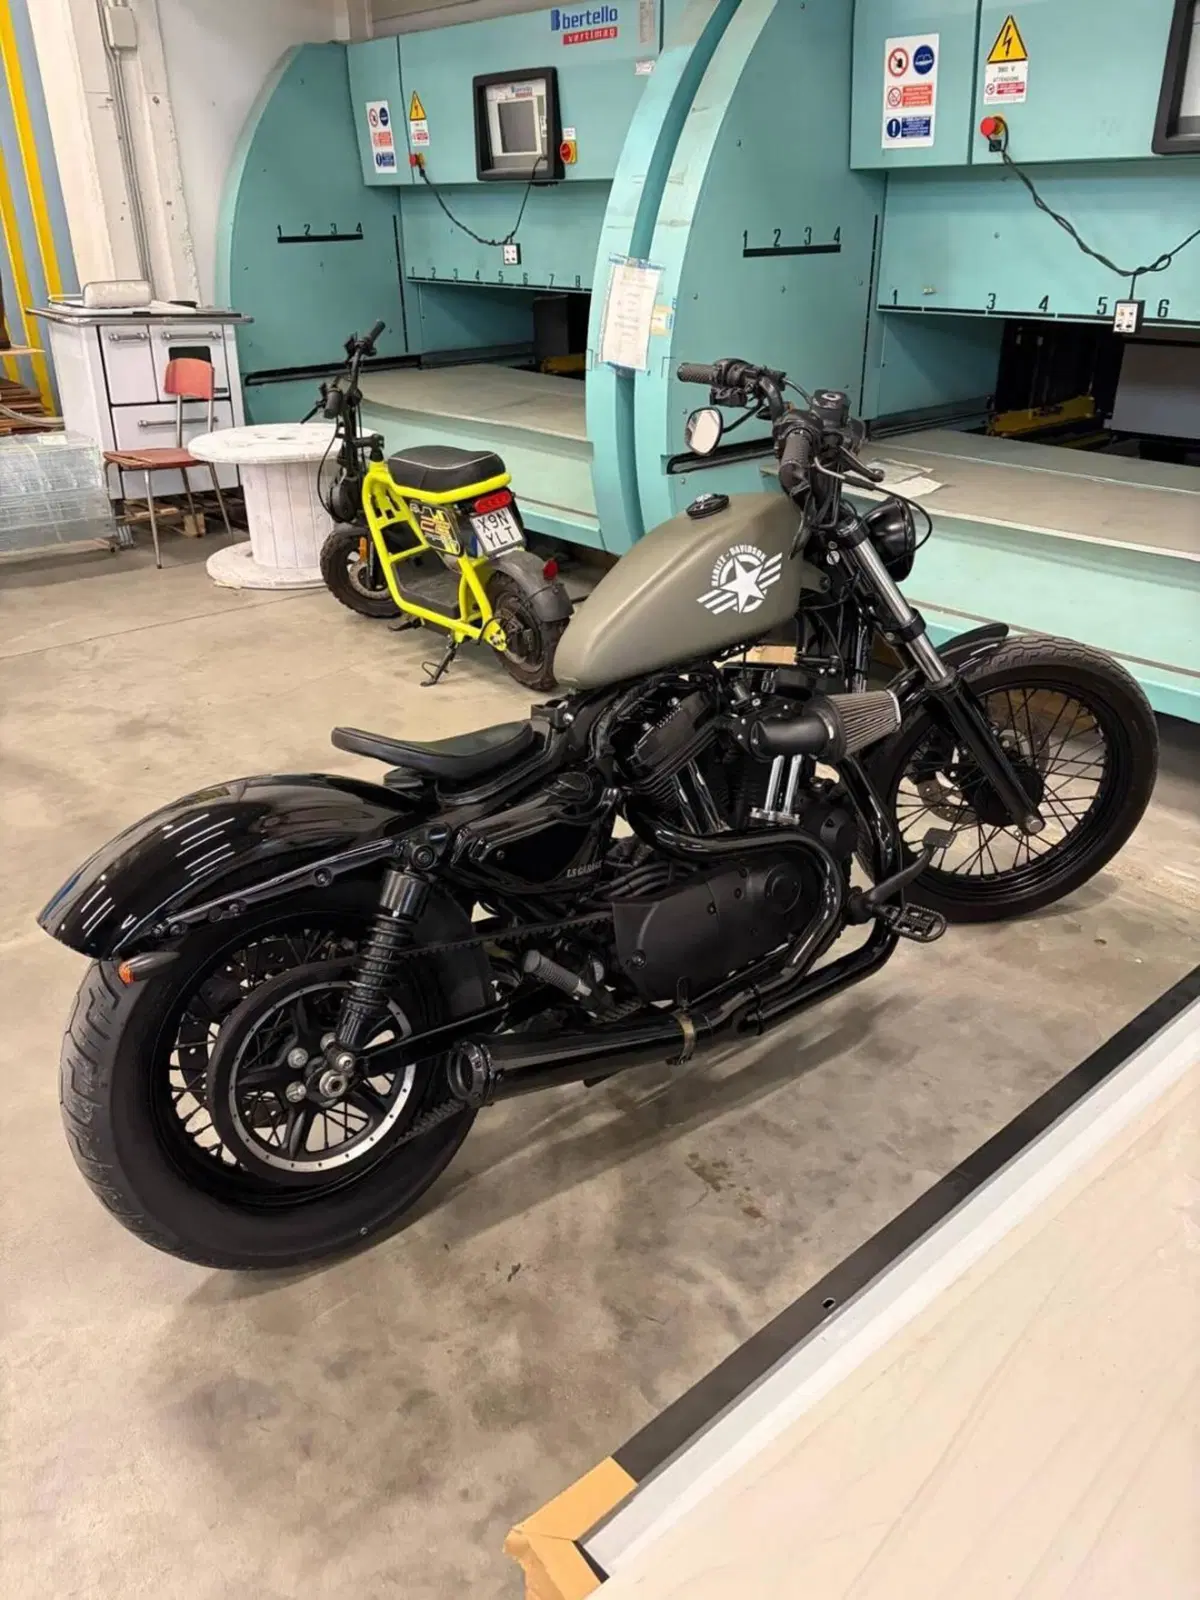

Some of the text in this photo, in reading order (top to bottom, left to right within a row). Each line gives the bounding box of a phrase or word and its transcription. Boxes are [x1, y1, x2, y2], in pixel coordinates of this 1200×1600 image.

[562, 5, 618, 30] bertello
[277, 221, 363, 237] 1 2 3 4
[743, 226, 841, 249] 1 2 3 4
[891, 289, 1170, 319] 1 3 4 5 6
[477, 510, 509, 533] X9N
[486, 525, 516, 548] YLT
